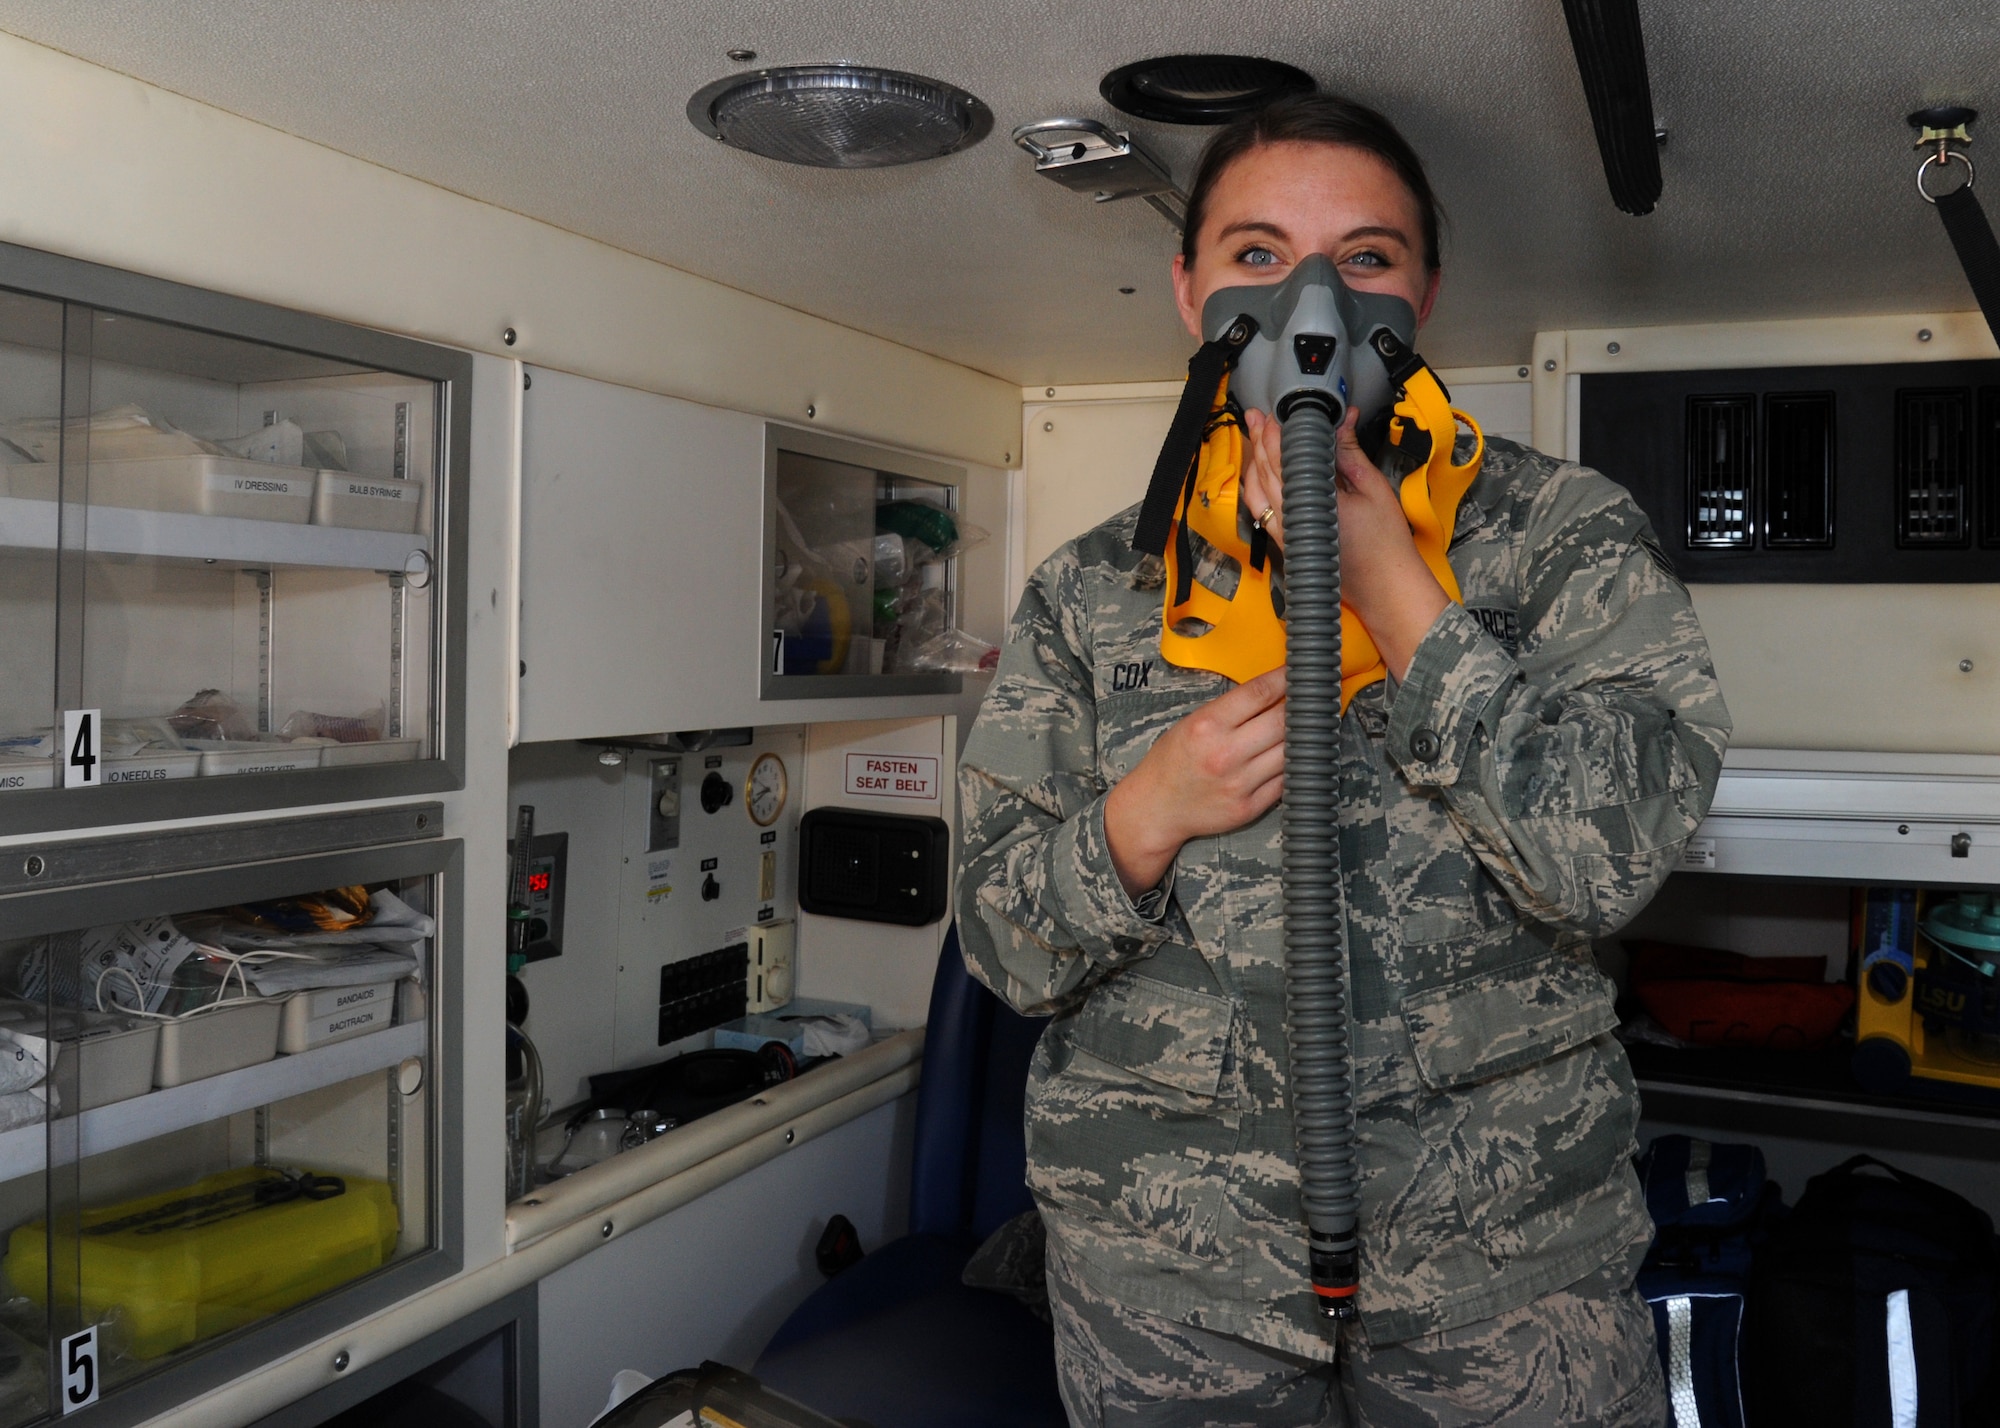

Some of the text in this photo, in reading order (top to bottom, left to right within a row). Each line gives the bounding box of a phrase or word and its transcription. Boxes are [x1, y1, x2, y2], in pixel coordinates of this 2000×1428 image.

[234, 480, 288, 493] IV DRESSING
[349, 484, 402, 499] BULB SYRINGE
[773, 632, 782, 673] 7
[1113, 661, 1153, 691] COX
[71, 714, 96, 781] 4
[121, 769, 166, 781] NEEDLES
[866, 760, 918, 774] FASTEN
[856, 777, 927, 792] SEAT BELT
[337, 989, 375, 1007] BANDAIDS
[1920, 983, 1966, 1013] LSU
[329, 1013, 374, 1033] BACITRACIN
[68, 1332, 93, 1403] 5
